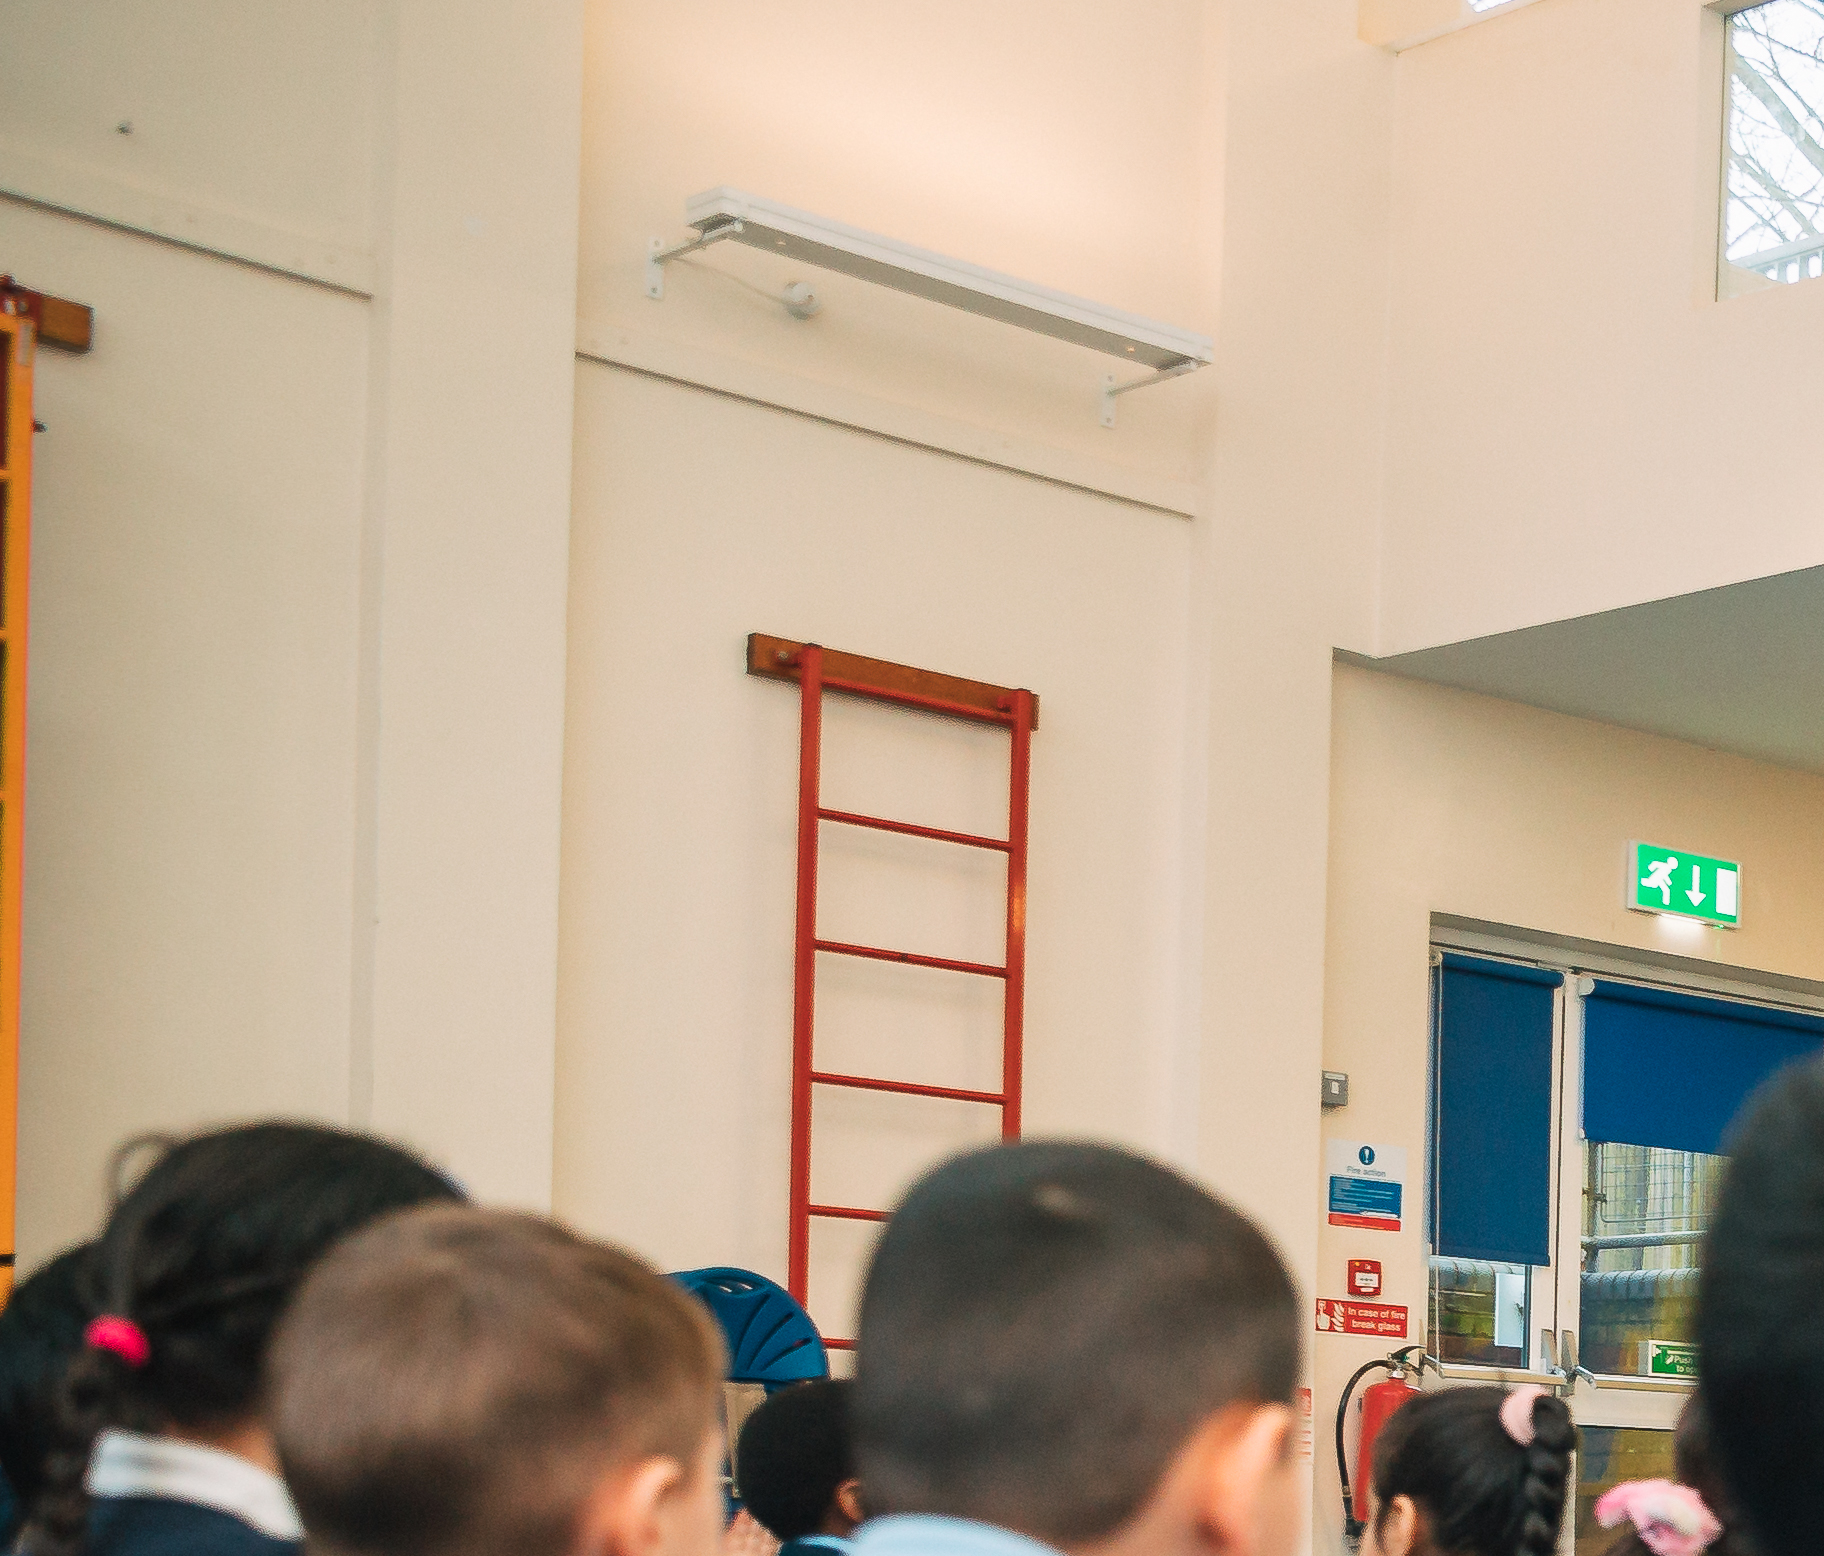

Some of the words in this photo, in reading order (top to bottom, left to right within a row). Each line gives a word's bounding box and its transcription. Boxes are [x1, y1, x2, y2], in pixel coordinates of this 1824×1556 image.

[1346, 1165, 1361, 1175] Fire
[1363, 1168, 1386, 1178] action
[1347, 1307, 1356, 1315] In
[1358, 1308, 1379, 1317] case
[1380, 1310, 1389, 1319] of
[1390, 1311, 1406, 1320] fire
[1351, 1319, 1375, 1329] break
[1377, 1322, 1401, 1332] glass
